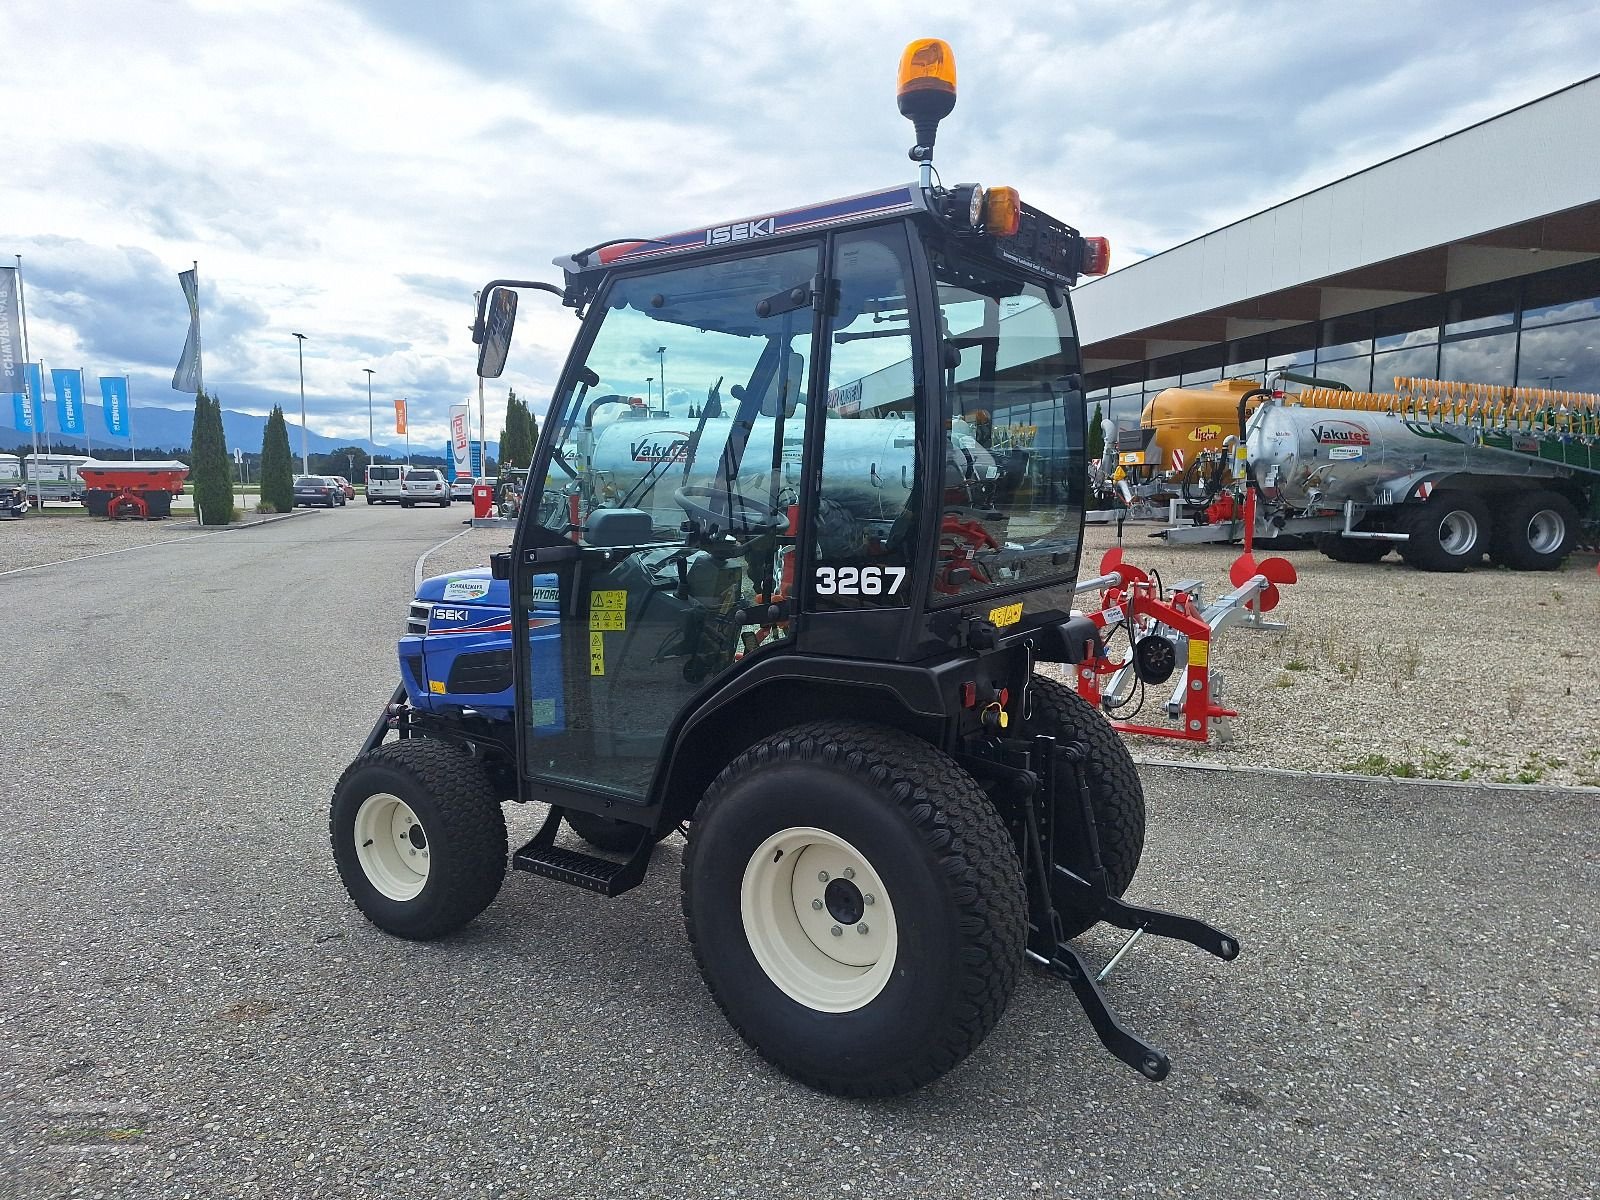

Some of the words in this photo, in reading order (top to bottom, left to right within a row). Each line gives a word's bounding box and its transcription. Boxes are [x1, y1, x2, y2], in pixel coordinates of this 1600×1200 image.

[705, 217, 775, 246] ISEKI
[1310, 425, 1370, 444] Vakutec
[630, 438, 689, 462] Vakute
[815, 566, 906, 595] 3267
[433, 608, 469, 621] ISEKI
